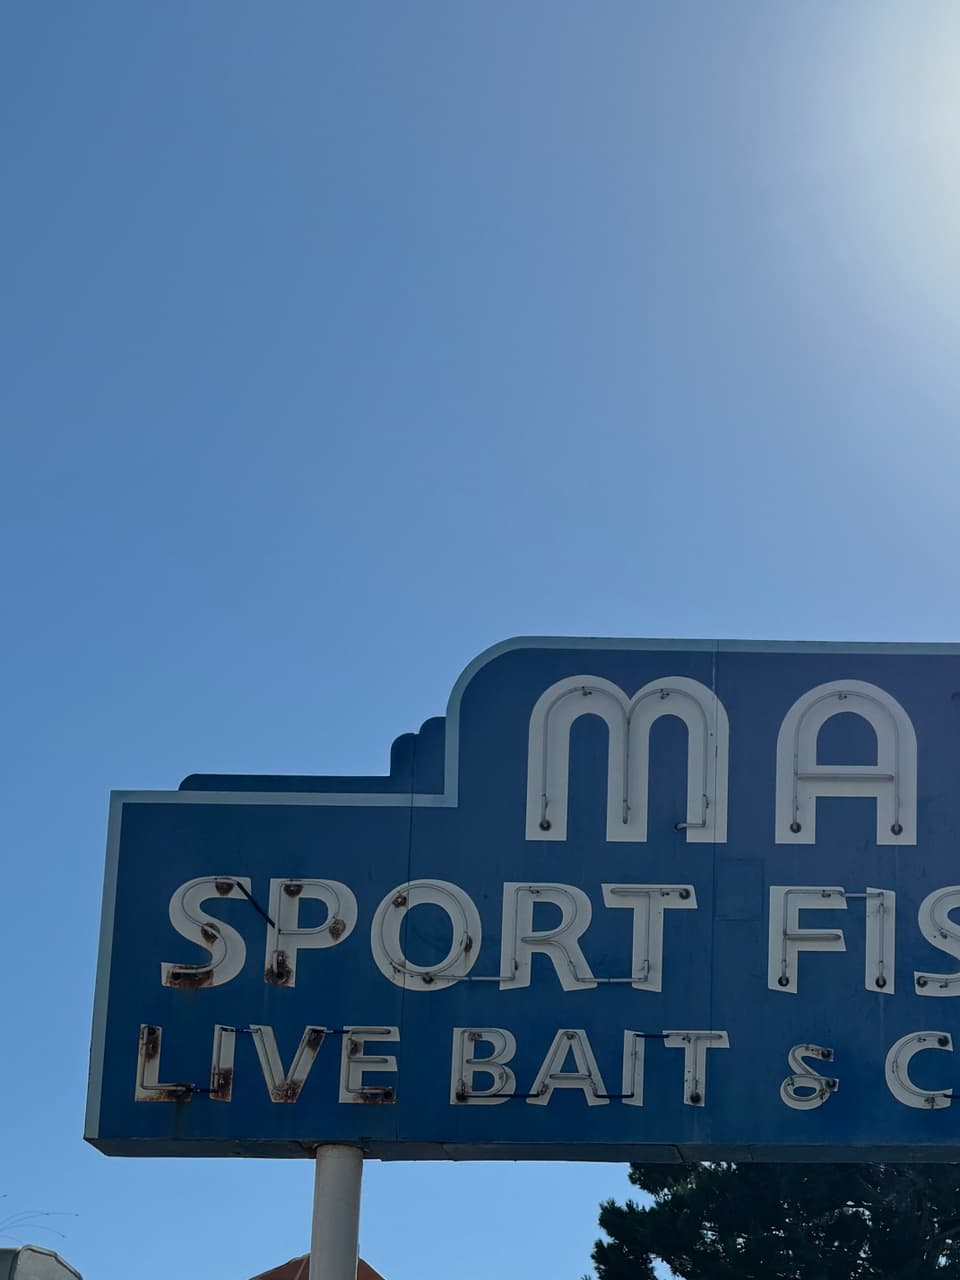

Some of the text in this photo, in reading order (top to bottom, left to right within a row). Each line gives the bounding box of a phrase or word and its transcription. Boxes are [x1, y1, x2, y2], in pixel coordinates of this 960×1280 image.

[160, 876, 698, 992] SPORT
[134, 1024, 400, 1105] LIVE
[450, 1027, 730, 1107] BAIT
[779, 1043, 840, 1111] &
